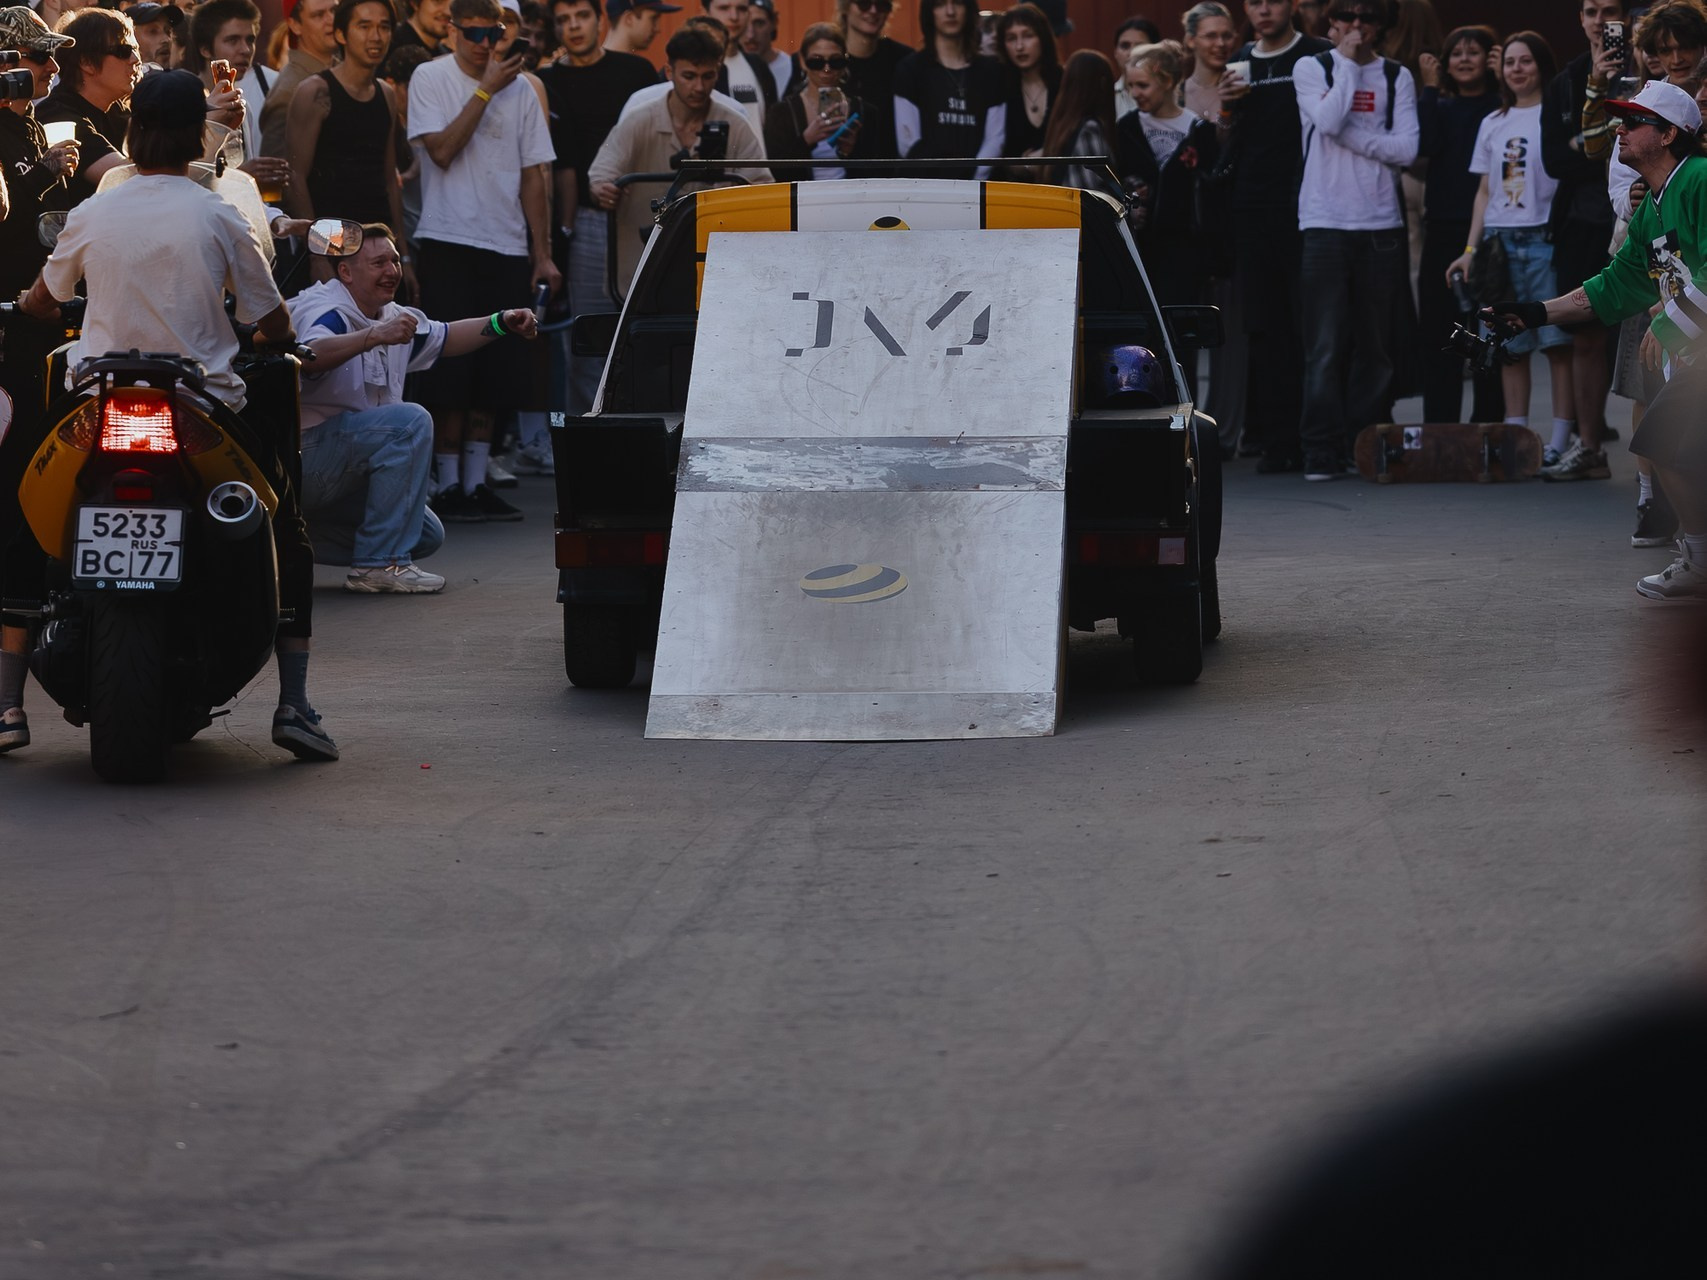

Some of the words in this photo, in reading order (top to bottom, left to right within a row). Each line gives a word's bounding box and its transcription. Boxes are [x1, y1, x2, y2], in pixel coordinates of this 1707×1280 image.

[92, 512, 167, 539] 5233
[130, 540, 158, 550] RUS
[137, 551, 174, 577] 77
[115, 581, 156, 590] YAMAHA
